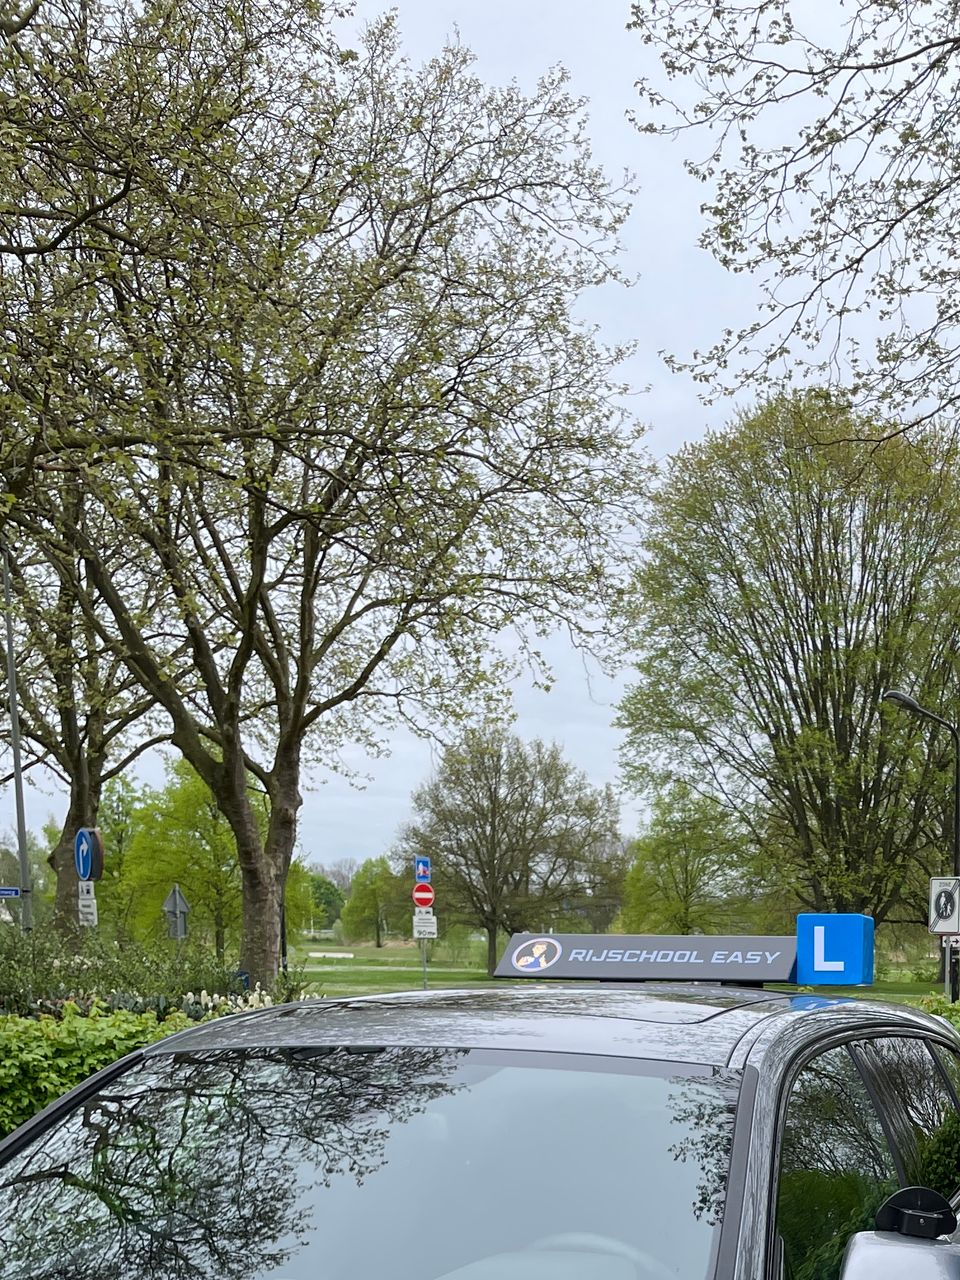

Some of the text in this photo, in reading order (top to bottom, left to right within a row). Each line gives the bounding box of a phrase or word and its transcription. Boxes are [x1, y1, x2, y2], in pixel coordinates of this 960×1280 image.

[568, 948, 782, 964] RIJSCHOOL EASY
[813, 925, 845, 972] L
